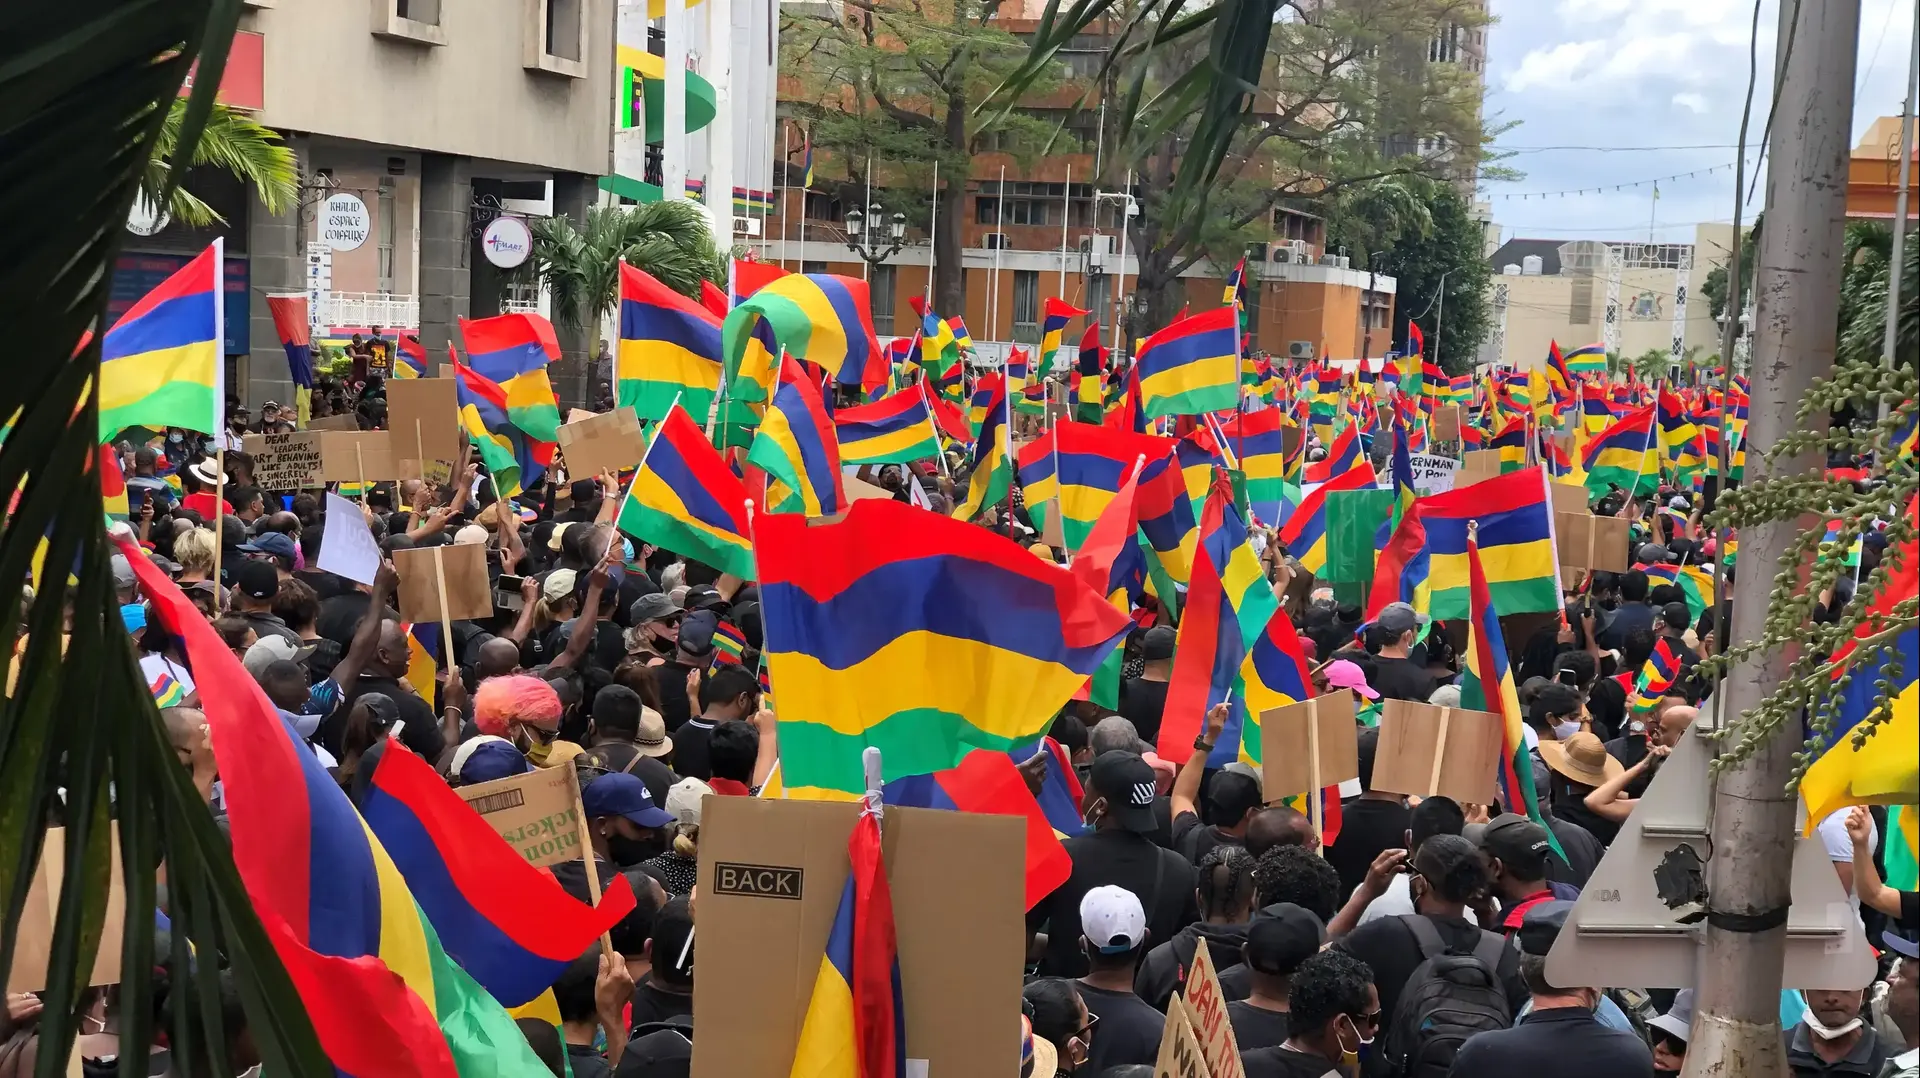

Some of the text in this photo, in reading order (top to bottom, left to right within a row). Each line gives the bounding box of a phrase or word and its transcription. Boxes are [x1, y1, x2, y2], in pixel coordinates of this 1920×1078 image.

[330, 202, 360, 212] KHALID
[329, 215, 361, 227] ESPACE
[325, 229, 365, 242] COIFFURE
[265, 433, 290, 445] DEAR
[277, 451, 320, 463] BEHAVING
[261, 459, 323, 472] LIKE ADULTS!
[266, 470, 313, 481] SINCERELY,
[261, 478, 299, 489] ZANFAN
[721, 868, 793, 894] BACK
